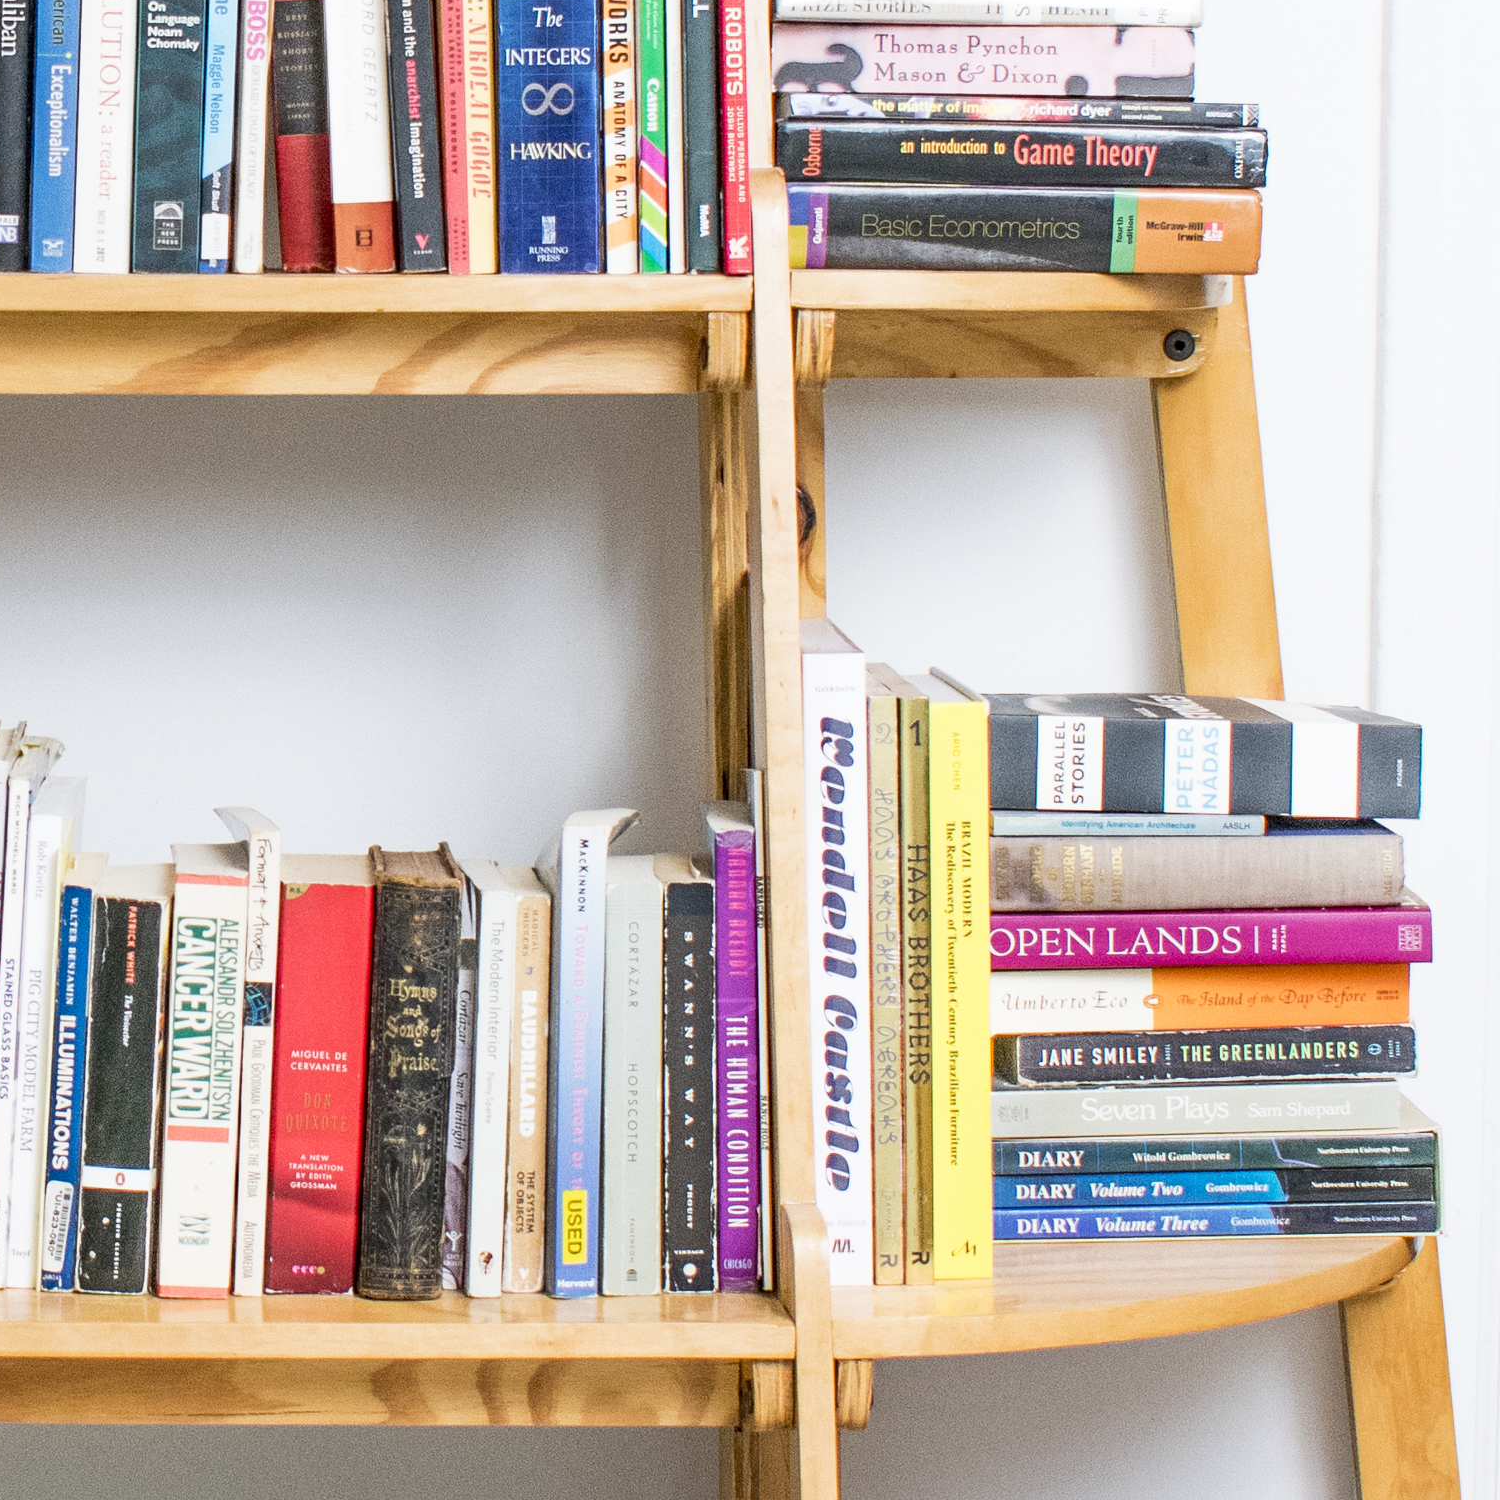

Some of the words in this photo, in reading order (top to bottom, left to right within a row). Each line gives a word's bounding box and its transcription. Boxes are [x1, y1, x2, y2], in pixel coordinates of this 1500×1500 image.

[533, 8, 562, 28] The
[505, 49, 591, 66] INTEGERS
[874, 34, 958, 55] Thomas
[967, 36, 1058, 58] Pynchon
[874, 63, 946, 82] Mason
[958, 63, 985, 83] &
[992, 64, 1057, 84] Dixon
[49, 64, 72, 177] Exceptionalism
[510, 142, 591, 159] HAWKING
[802, 127, 822, 177] Osborne
[900, 140, 914, 154] an
[921, 139, 987, 155] introduction
[994, 140, 1005, 154] to
[1014, 135, 1074, 165] Game
[1083, 137, 1157, 175] Theory
[861, 216, 921, 237] Basic
[928, 218, 1079, 239] Econometrics
[990, 927, 1095, 957] OPEN
[1106, 926, 1242, 954] LANDS
[726, 1016, 748, 1050] THE
[1039, 1048, 1086, 1067] JANE
[1092, 1046, 1158, 1064] SMILEY
[1181, 1045, 1212, 1061] THE
[1220, 1040, 1359, 1061] GREENLANDERS
[52, 1015, 78, 1171] ILLUMINATIONS
[726, 1059, 748, 1129] HUMAN
[1017, 1150, 1084, 1168] DIARY
[727, 1131, 749, 1229] CONDITION
[1016, 1183, 1075, 1200] DIARY
[1090, 1182, 1144, 1197] Volume
[1152, 1181, 1182, 1198] Two
[567, 1198, 581, 1256] USED
